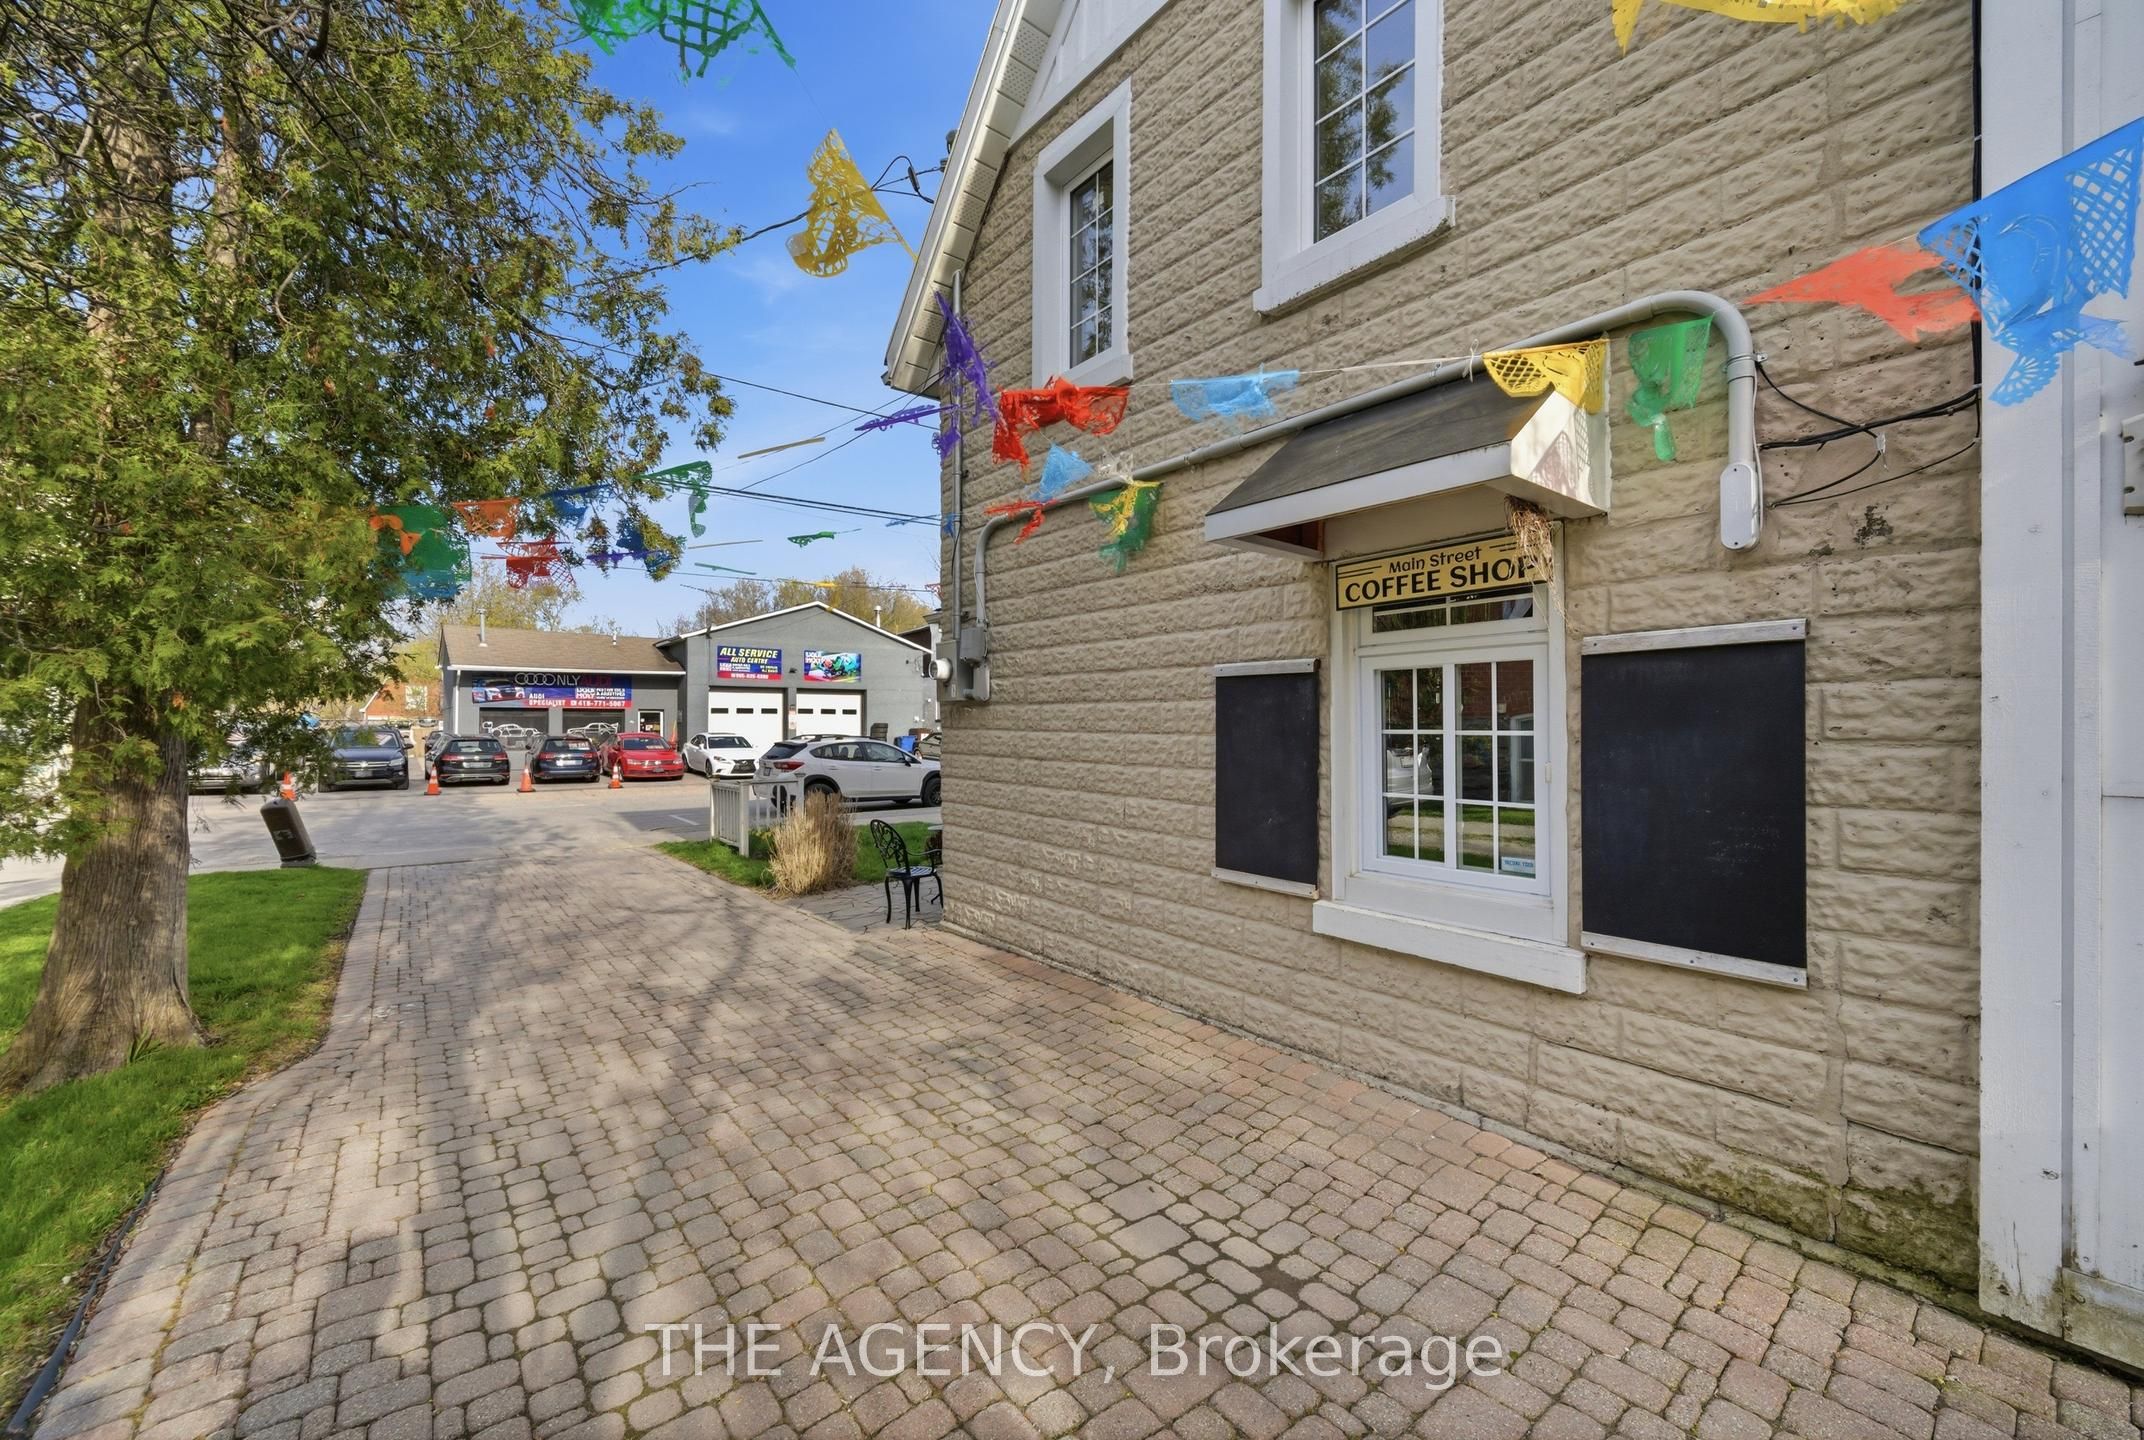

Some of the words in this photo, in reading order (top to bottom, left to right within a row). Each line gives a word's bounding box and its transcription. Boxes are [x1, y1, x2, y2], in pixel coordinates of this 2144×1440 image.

[1389, 557, 1425, 574] Main
[1429, 546, 1482, 567] Street
[1345, 569, 1441, 603] COFFEE
[720, 647, 737, 656] ALL
[738, 649, 778, 658] SERVICE
